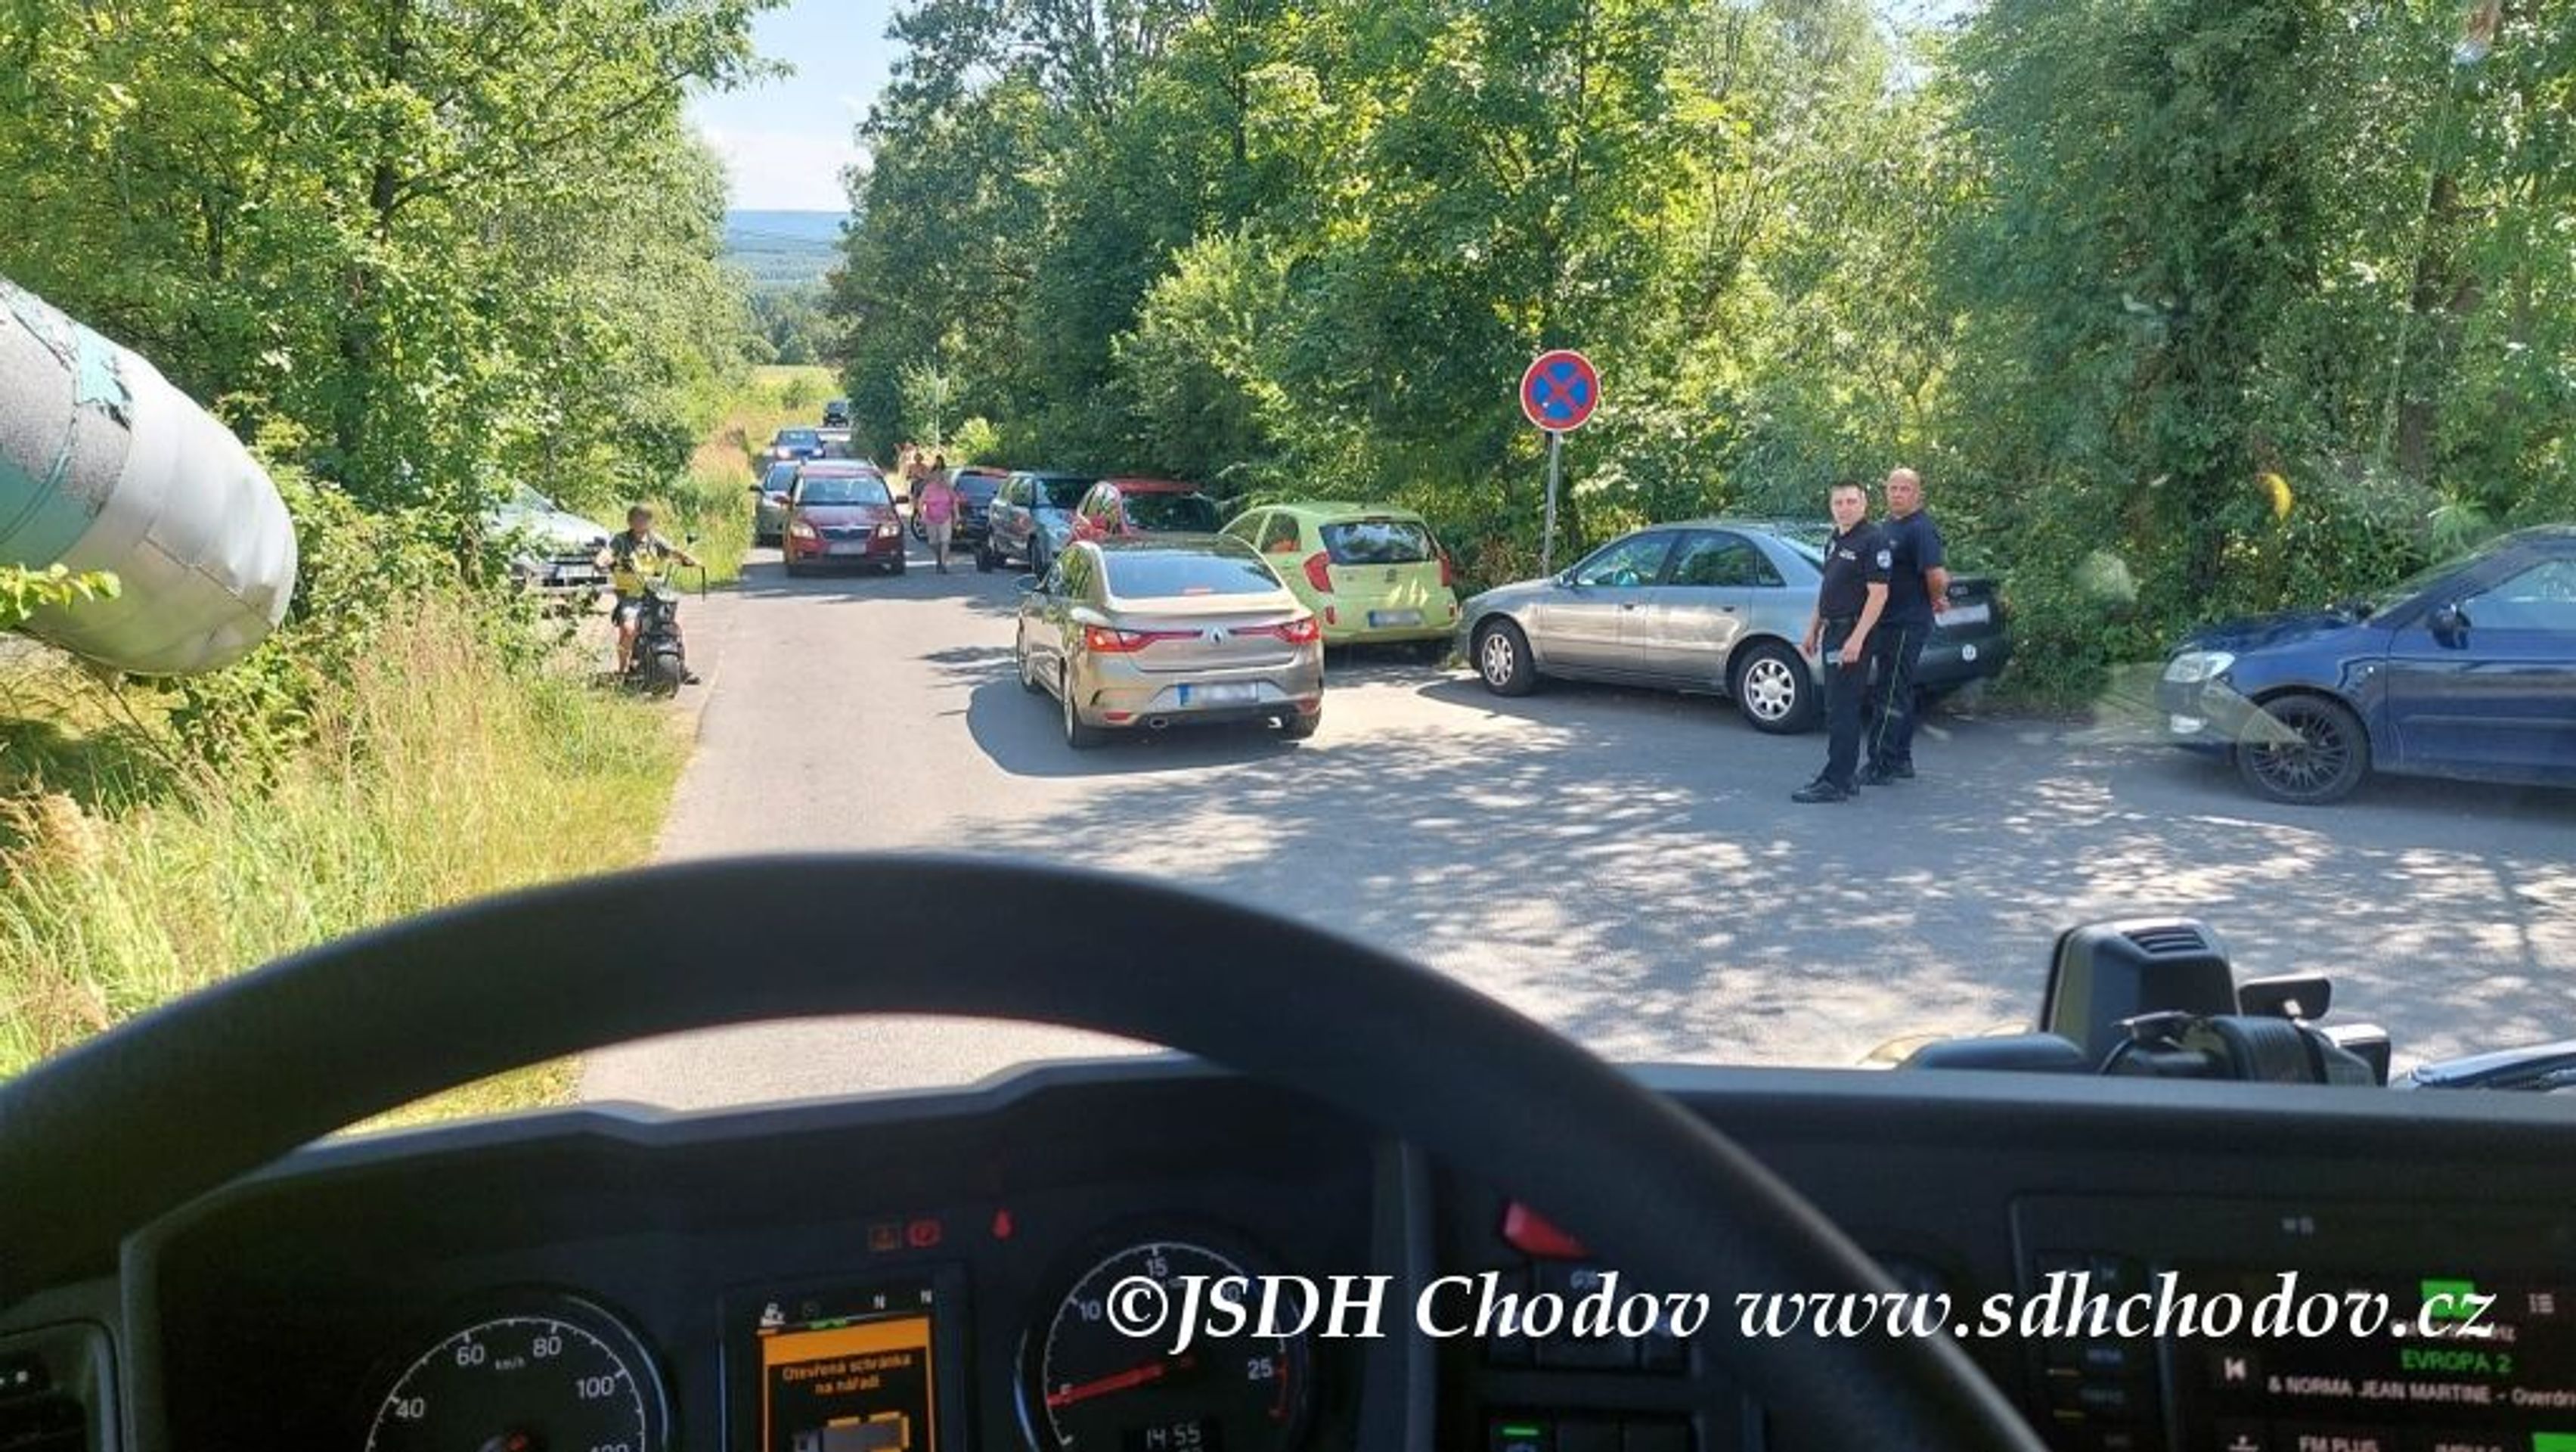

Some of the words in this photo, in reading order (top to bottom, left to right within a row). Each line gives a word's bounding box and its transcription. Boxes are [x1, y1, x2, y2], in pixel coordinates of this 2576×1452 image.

[1145, 1257, 1168, 1277] 15
[1079, 1301, 1102, 1320] 10
[456, 1343, 485, 1366] 60
[532, 1336, 562, 1358] 80
[1248, 1359, 1273, 1380] 25
[2400, 1348, 2492, 1373] EVROPA
[2496, 1354, 2513, 1374] 2
[576, 1373, 615, 1399] 100
[814, 1381, 834, 1395] na
[2285, 1376, 2354, 1398] NORMA
[2357, 1379, 2407, 1401] JEAN
[2409, 1381, 2491, 1404] MARTINE
[395, 1398, 425, 1419] 40
